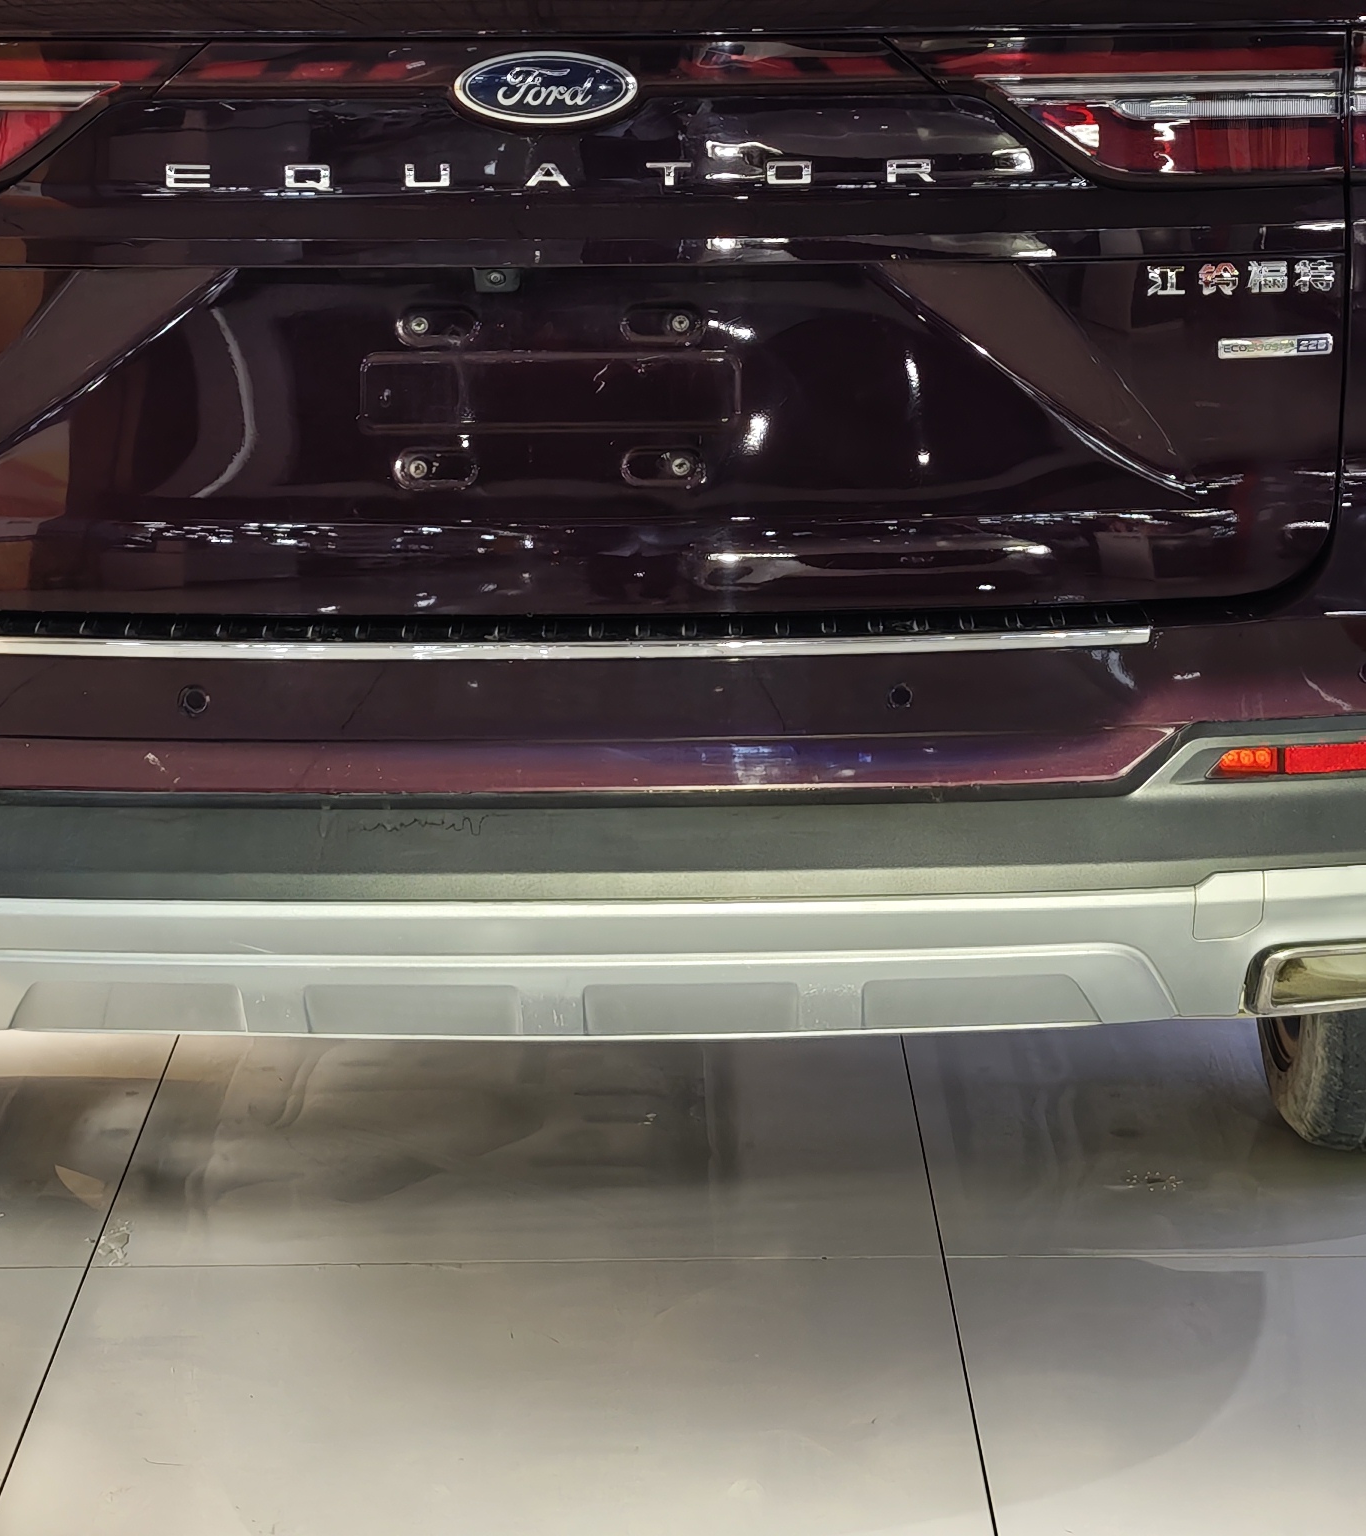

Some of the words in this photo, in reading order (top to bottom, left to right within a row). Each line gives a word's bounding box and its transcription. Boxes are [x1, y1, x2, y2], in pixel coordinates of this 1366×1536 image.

[495, 65, 593, 108] Ford
[166, 160, 935, 192] EQUATOR
[1146, 259, 1336, 296] 江铃福特
